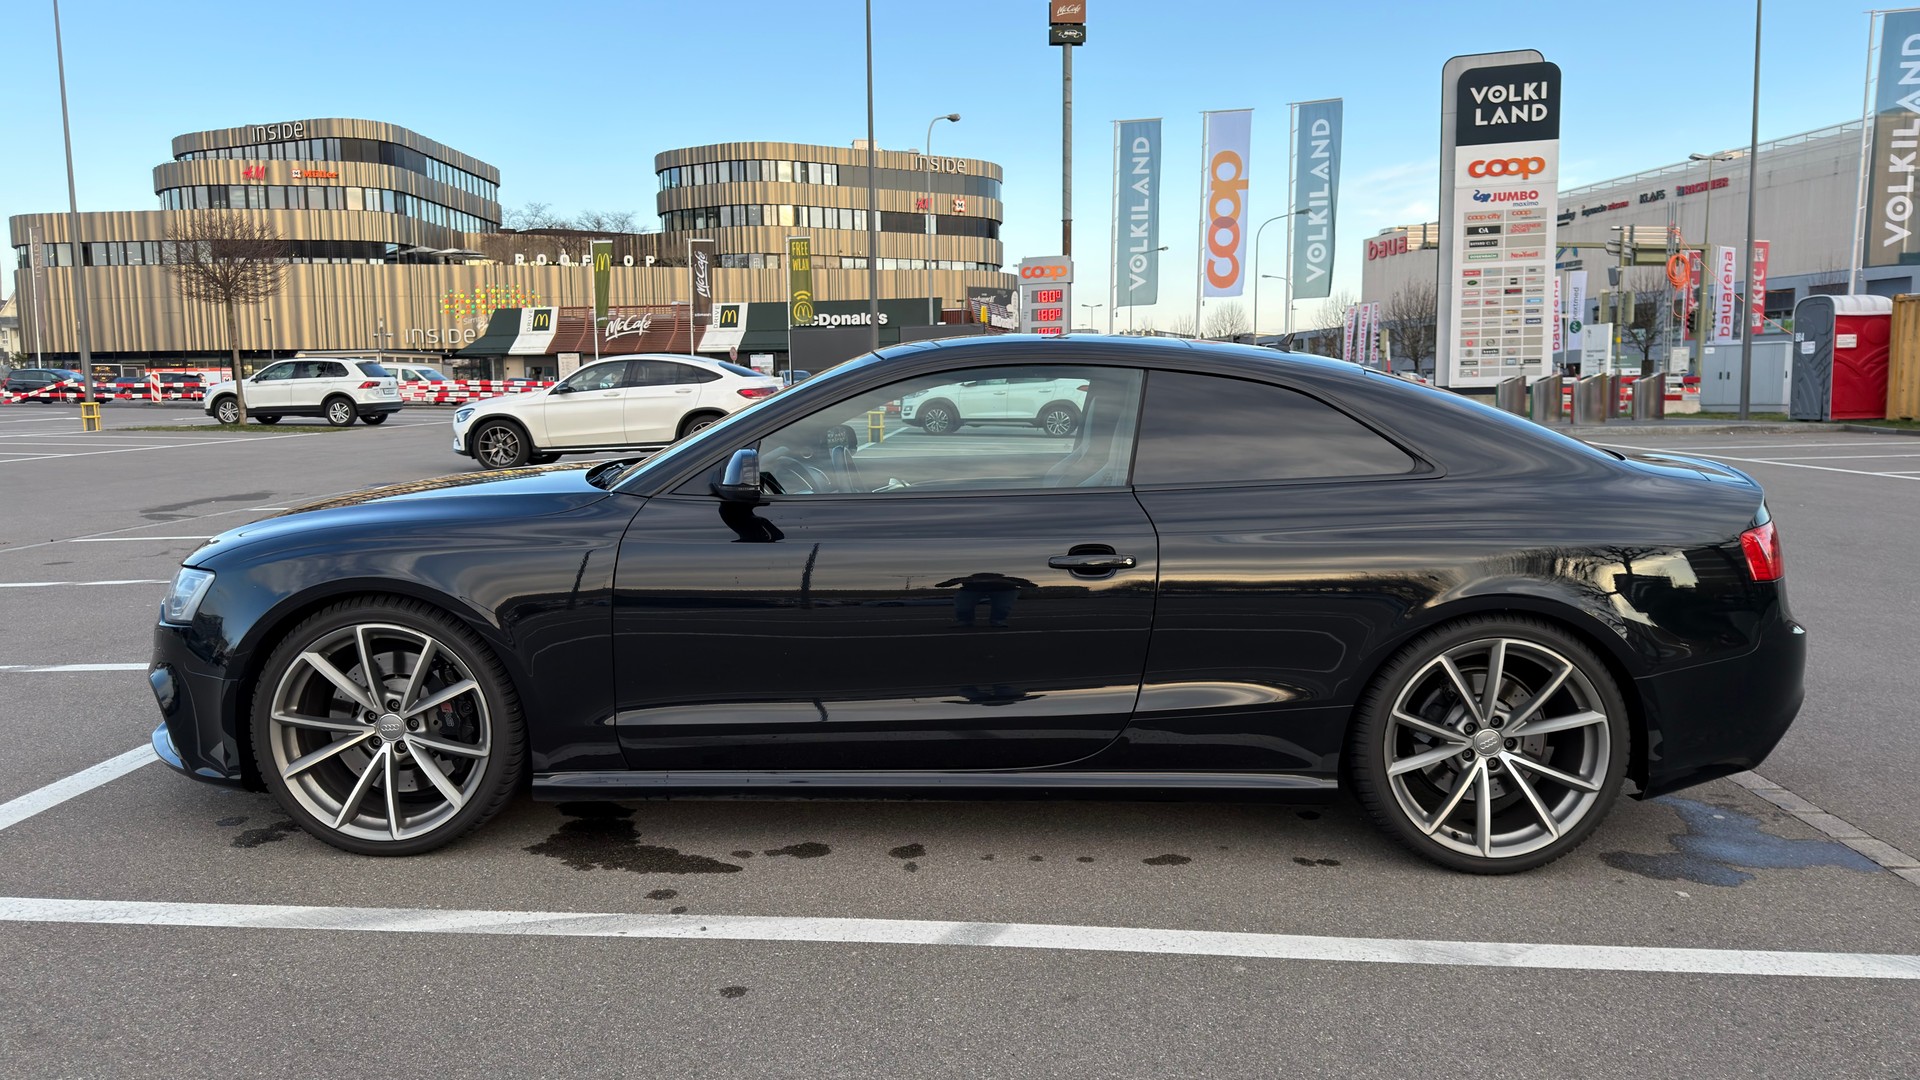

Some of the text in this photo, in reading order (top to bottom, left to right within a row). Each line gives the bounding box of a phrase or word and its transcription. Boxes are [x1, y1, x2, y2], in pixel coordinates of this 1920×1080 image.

[1470, 81, 1547, 104] VOLKI
[1475, 103, 1548, 126] LAND
[1468, 157, 1545, 180] coop
[1306, 118, 1330, 283] VOLKILAND
[1490, 190, 1539, 202] JUMBO
[1129, 136, 1150, 291] VOLKILAND
[1207, 150, 1249, 289] coop
[792, 242, 808, 256] FREE
[1368, 236, 1409, 261] baua
[793, 259, 810, 271] WLAN
[1021, 265, 1067, 281] coop
[1719, 251, 1734, 337] bauarena
[1752, 268, 1764, 306] KFC
[605, 313, 651, 342] McCafé
[713, 306, 721, 329] DRIVE
